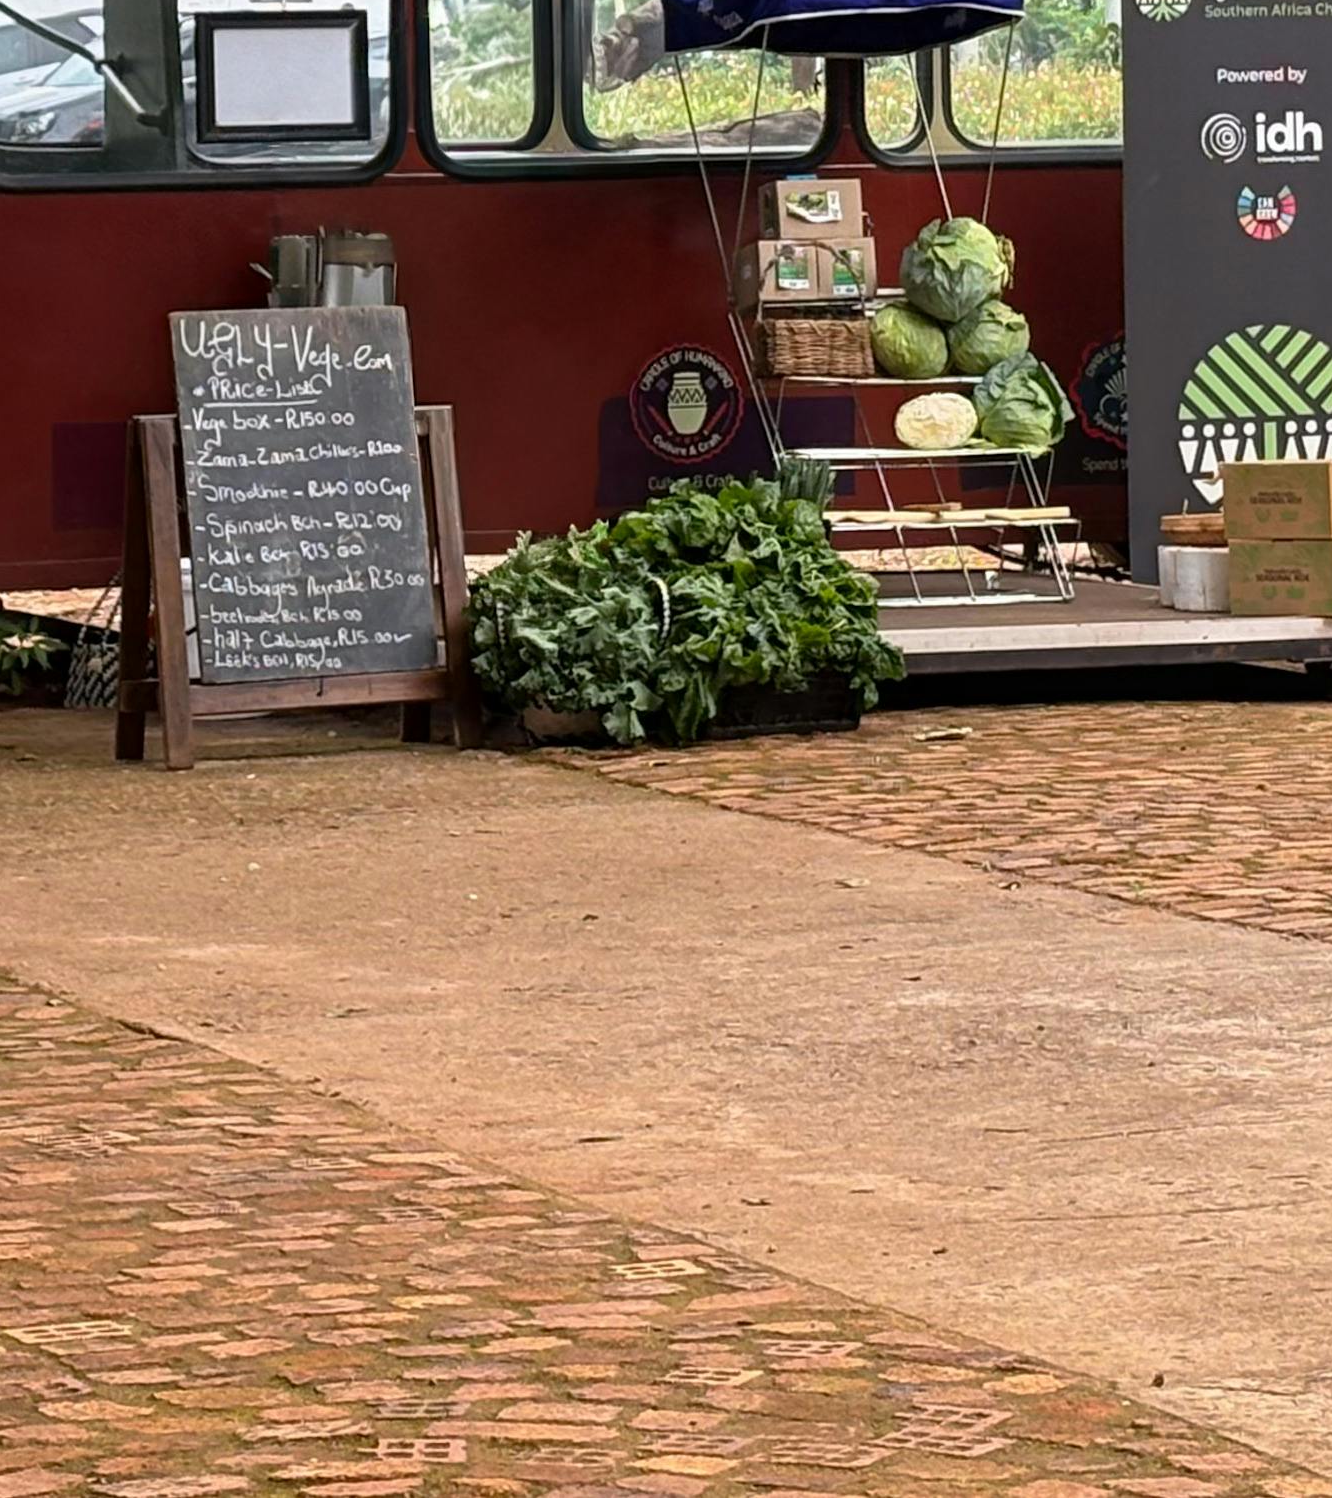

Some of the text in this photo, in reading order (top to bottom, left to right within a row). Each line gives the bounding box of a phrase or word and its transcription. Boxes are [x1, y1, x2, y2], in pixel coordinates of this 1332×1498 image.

[1205, 4, 1268, 19] Southern
[1271, 3, 1312, 17] Africa
[1217, 66, 1307, 84] Powered by
[1255, 111, 1324, 153] idh
[640, 356, 669, 392] CRADLE
[669, 351, 682, 365] OF
